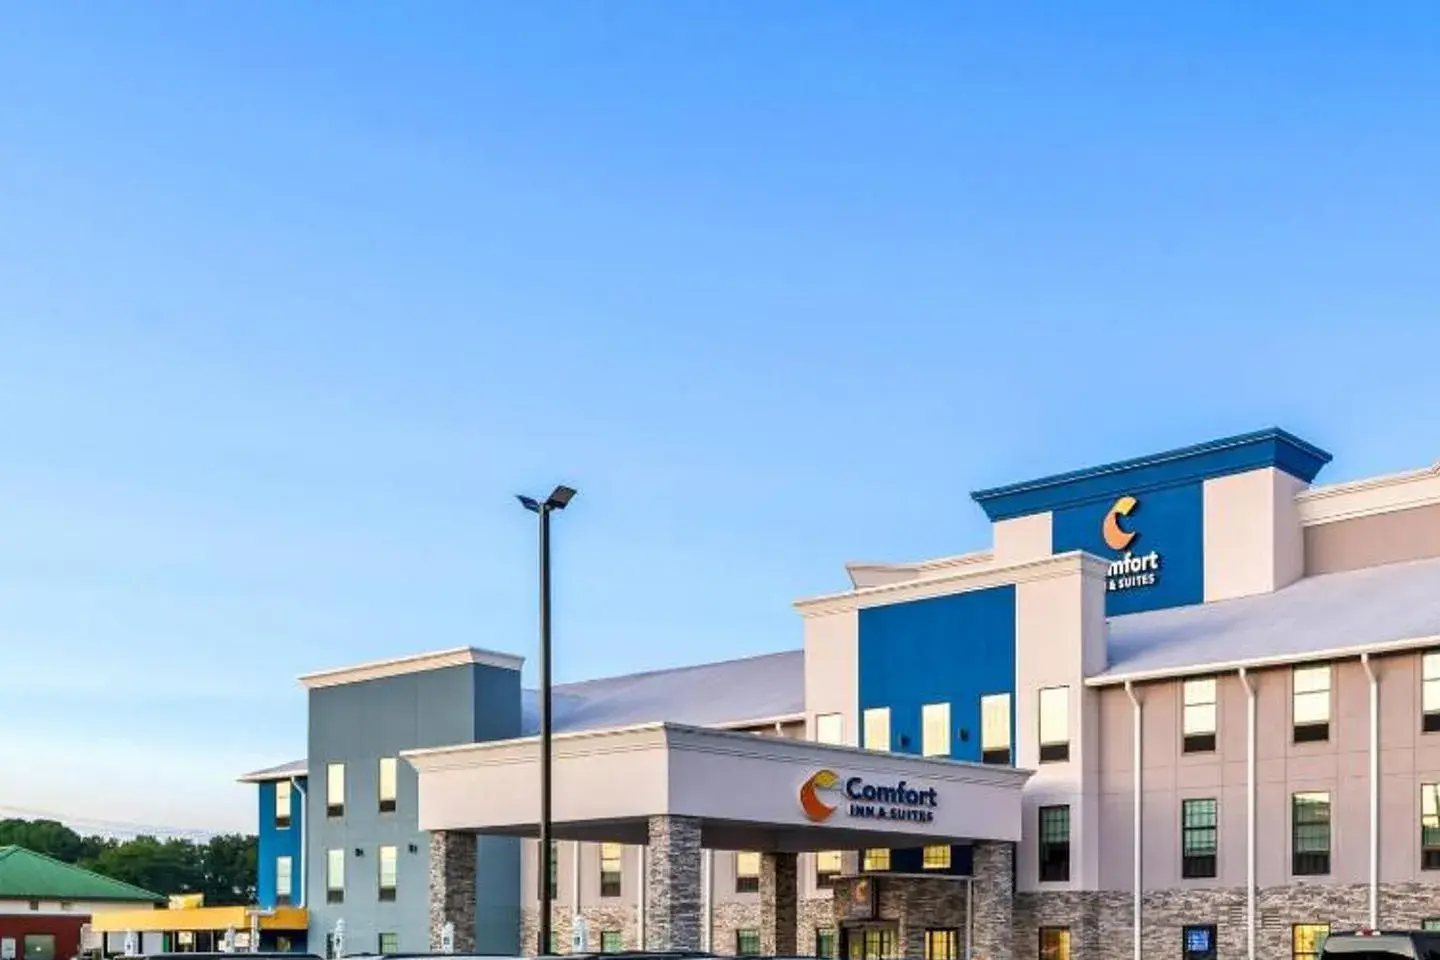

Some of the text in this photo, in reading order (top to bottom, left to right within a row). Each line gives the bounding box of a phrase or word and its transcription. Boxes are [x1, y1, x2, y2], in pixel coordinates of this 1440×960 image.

[1107, 551, 1158, 576] mfort
[1118, 573, 1155, 589] SUITES
[846, 777, 938, 807] Comfort
[849, 803, 934, 823] INN & SUITES
